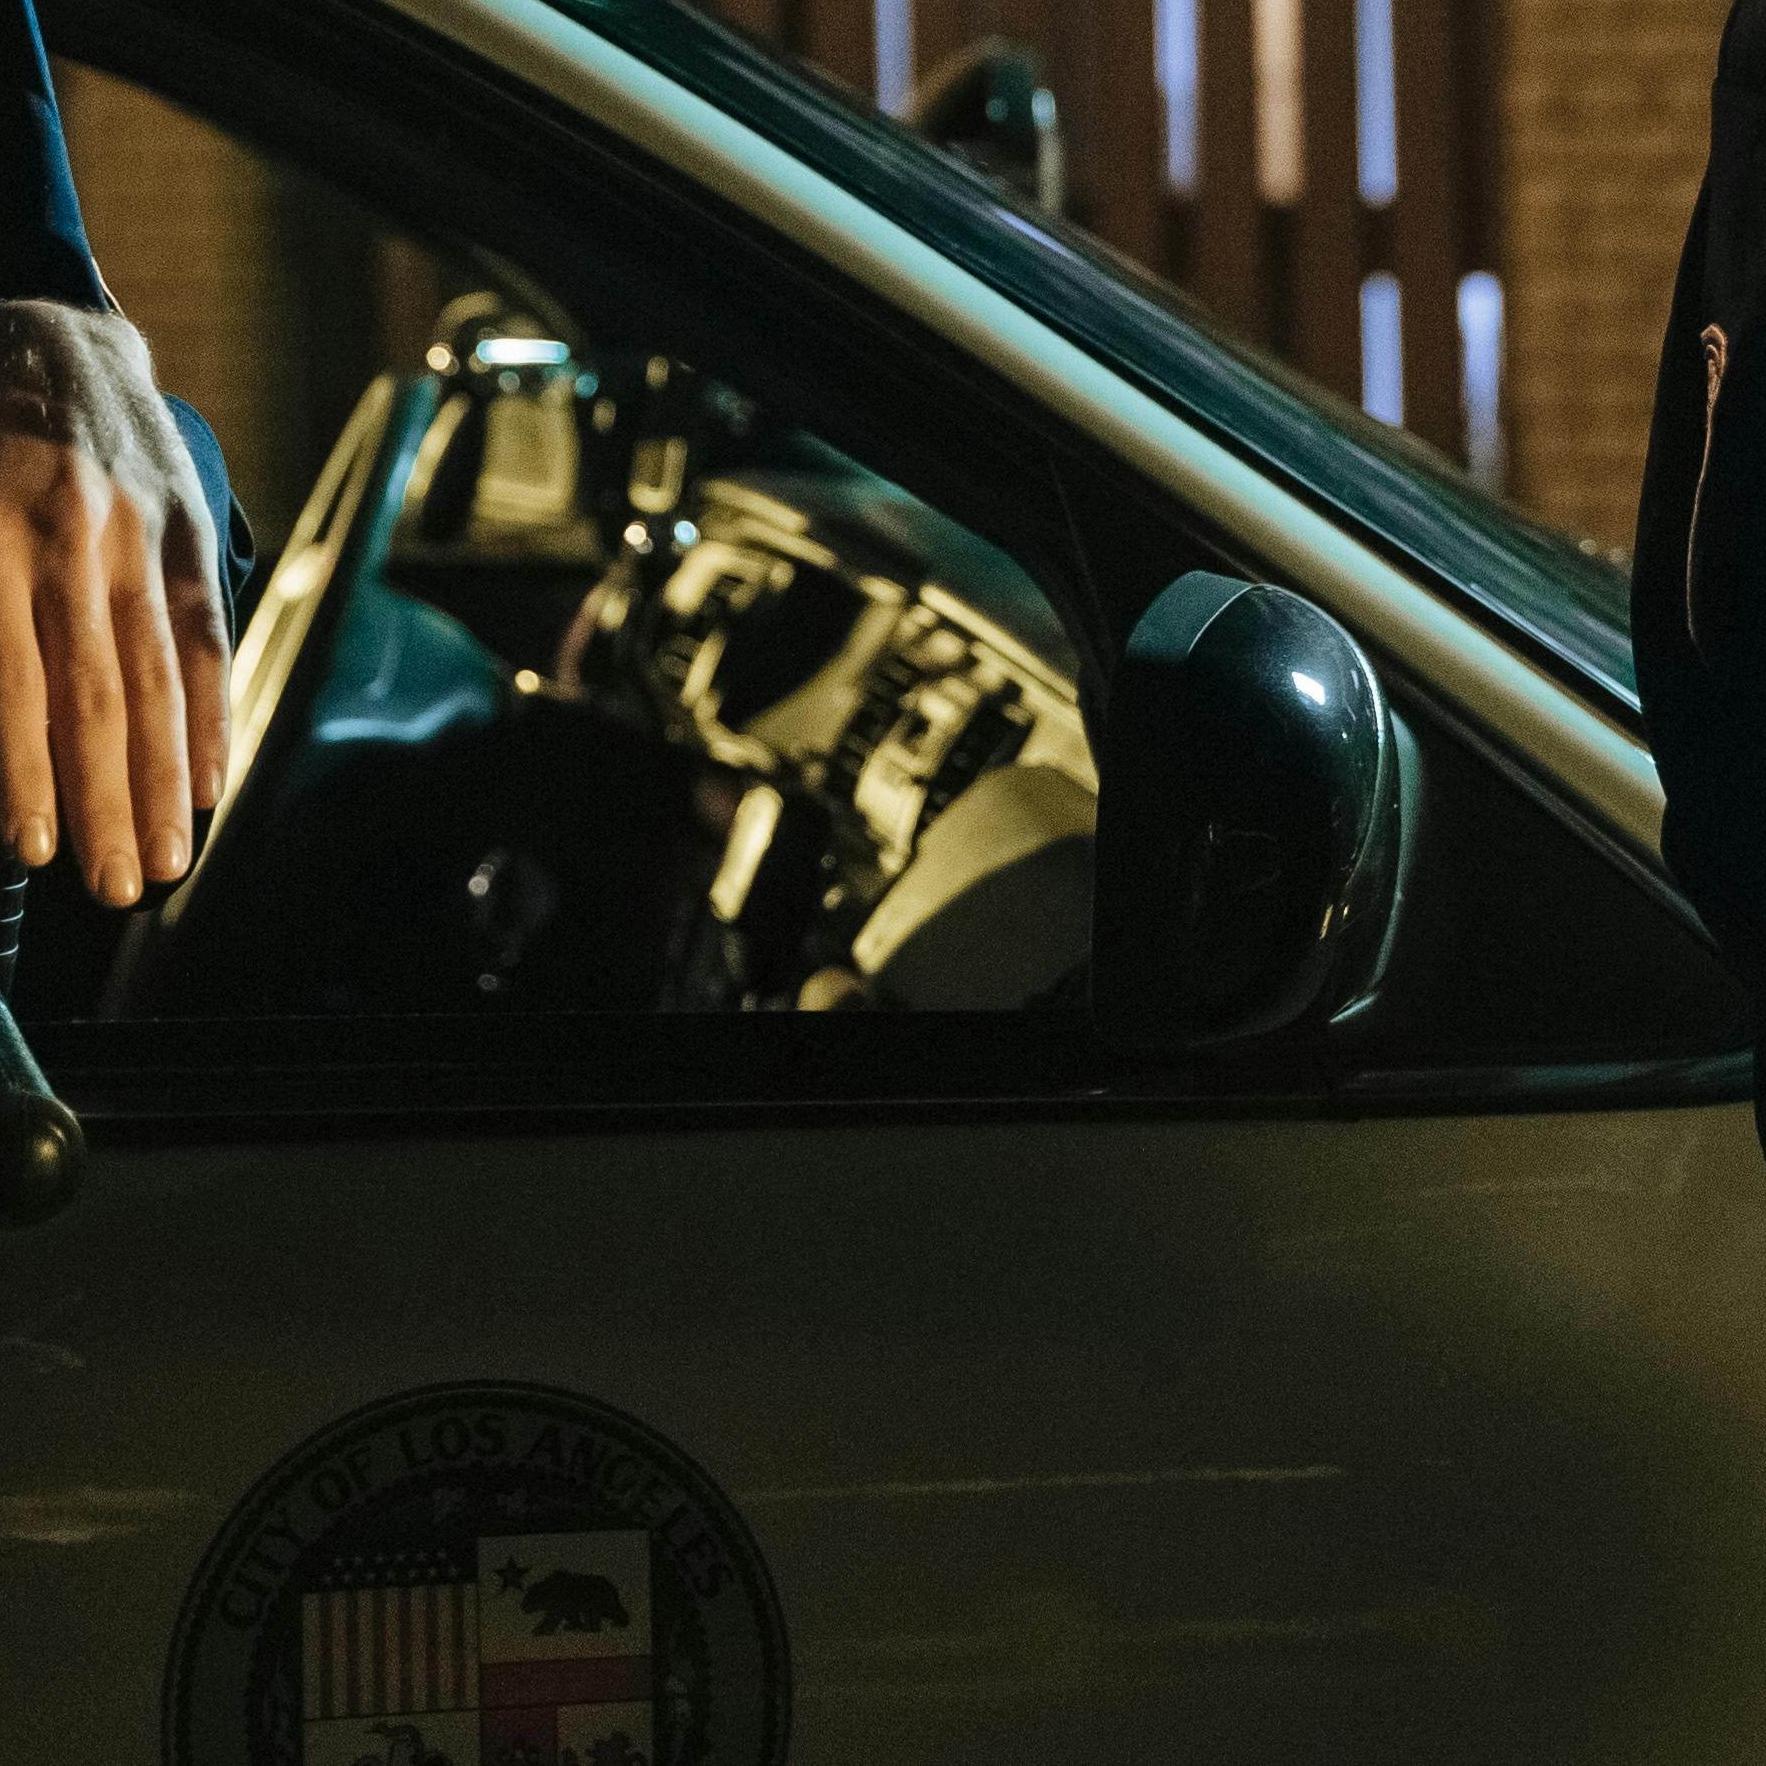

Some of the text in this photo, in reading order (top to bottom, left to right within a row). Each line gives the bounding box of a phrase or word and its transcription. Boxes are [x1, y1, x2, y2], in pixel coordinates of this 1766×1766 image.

[219, 1412, 732, 1630] CITY OF LOS ANGELES
